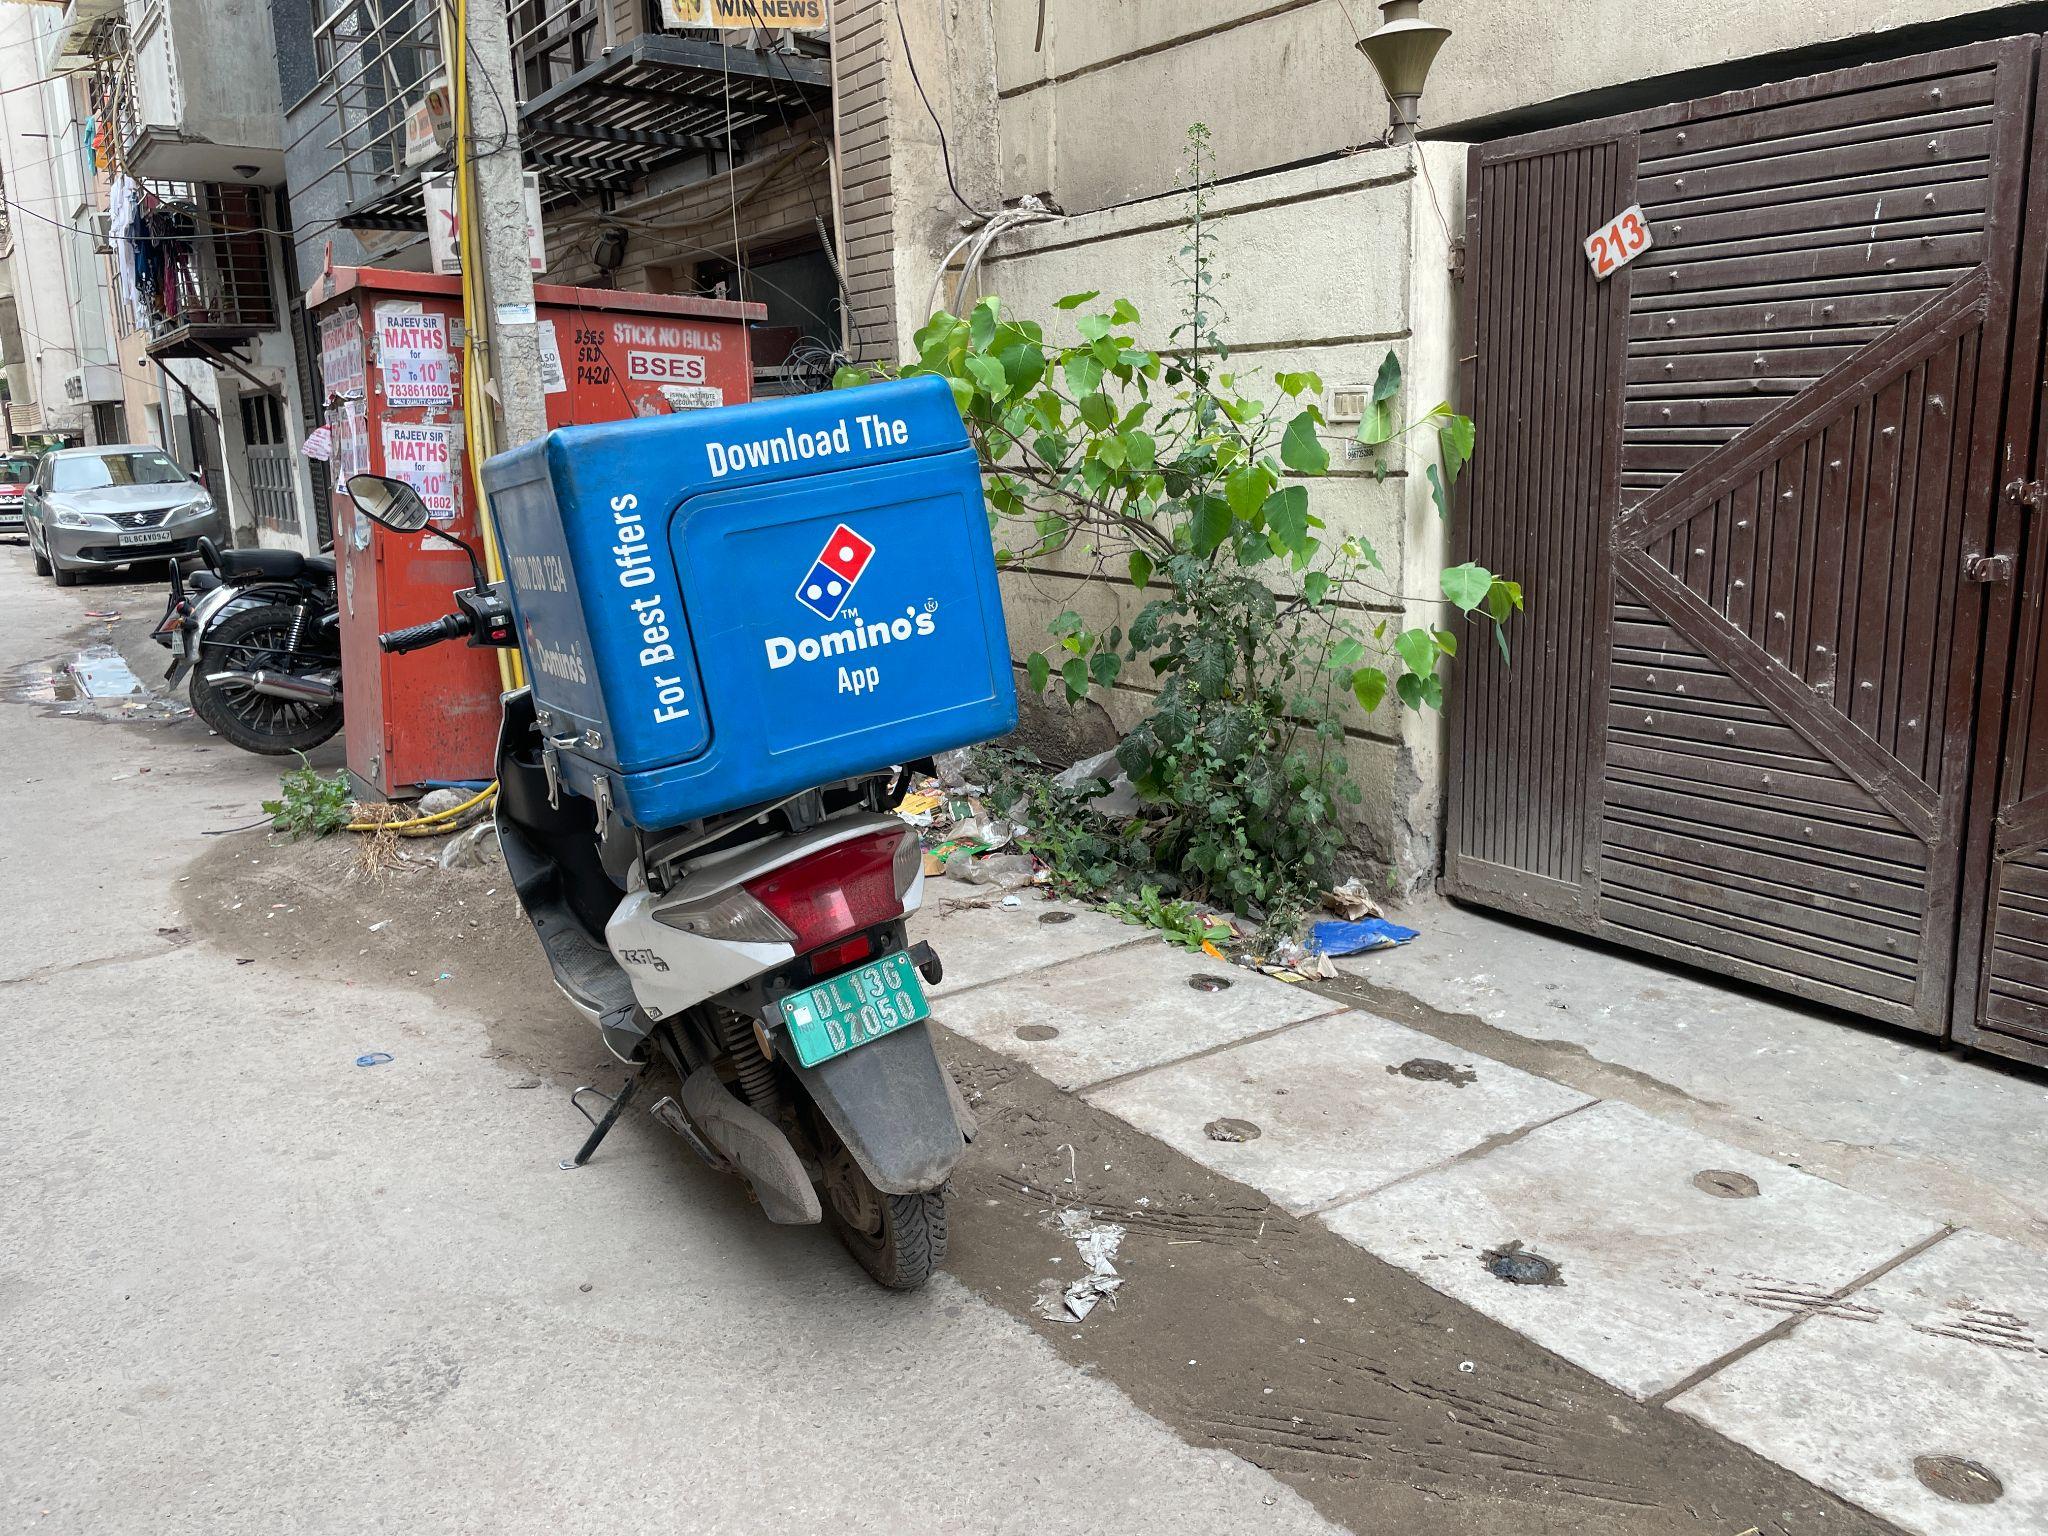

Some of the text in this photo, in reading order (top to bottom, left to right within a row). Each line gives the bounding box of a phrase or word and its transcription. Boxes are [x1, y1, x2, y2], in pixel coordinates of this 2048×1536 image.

[762, 0, 820, 18] NEWS
[1590, 214, 1644, 274] 213
[388, 317, 437, 328] RAJEEV SIR
[385, 328, 444, 350] MATHS
[574, 329, 605, 346] BSES
[613, 322, 722, 352] STICK NO BILLS
[410, 350, 421, 358] for
[578, 348, 600, 362] SRD
[392, 361, 442, 382] 5th To 10th
[578, 366, 610, 385] P420
[631, 356, 702, 378] BSES
[389, 384, 450, 397] 7838611802
[394, 430, 443, 442] RAJEEV SIR
[706, 414, 908, 478] Download The
[391, 441, 448, 462] MATHS
[415, 462, 426, 471] for
[423, 474, 446, 494] 10th
[544, 556, 568, 592] 1234
[610, 493, 690, 724] For Best Offers
[764, 606, 936, 670] Domino's
[536, 638, 586, 684] Domino's
[838, 666, 880, 696] App
[619, 948, 664, 964] ZEAL
